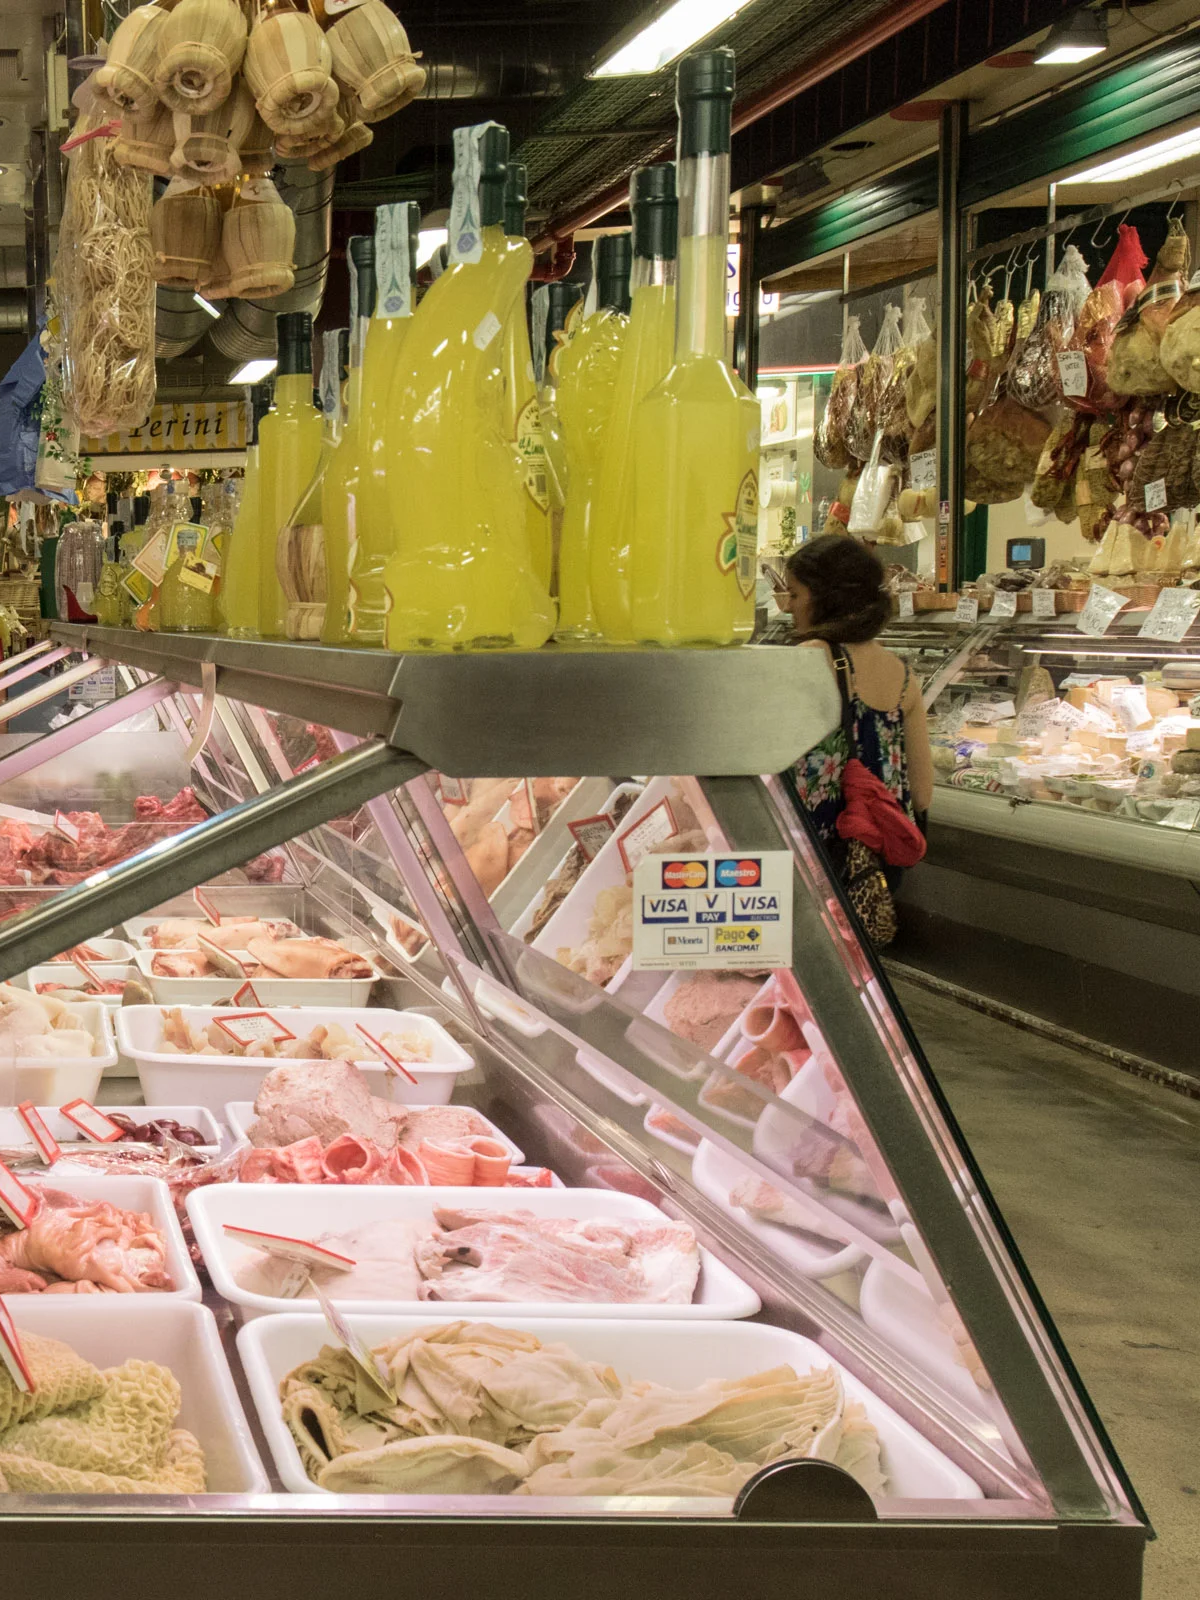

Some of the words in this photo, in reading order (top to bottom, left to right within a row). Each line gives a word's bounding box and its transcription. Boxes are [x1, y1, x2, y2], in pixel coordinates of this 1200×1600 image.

[664, 870, 707, 880] MasterCard
[720, 869, 756, 878] Maestro
[649, 899, 688, 913] VISA
[704, 894, 719, 909] V
[739, 896, 778, 910] VISA
[701, 913, 720, 922] PAY
[677, 935, 704, 945] Moneta
[715, 927, 746, 943] Pago
[715, 944, 760, 952] BANCOMAT
